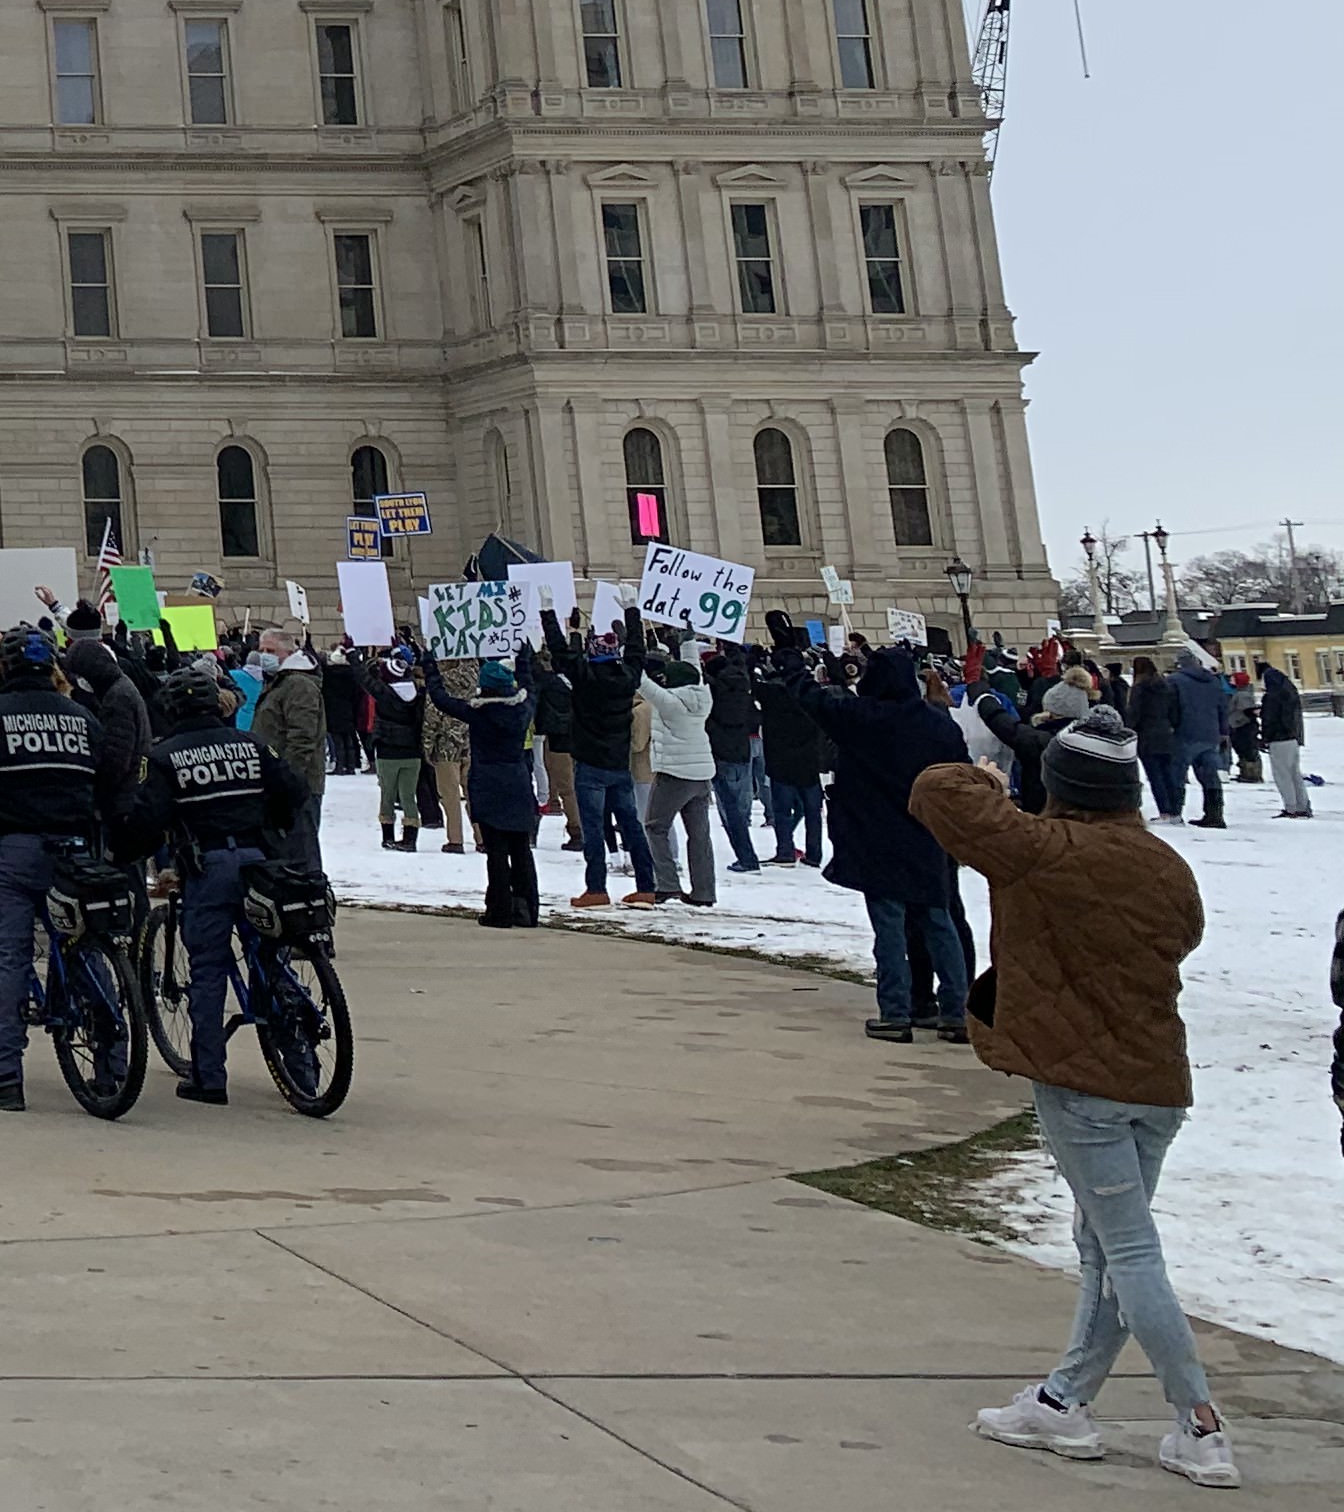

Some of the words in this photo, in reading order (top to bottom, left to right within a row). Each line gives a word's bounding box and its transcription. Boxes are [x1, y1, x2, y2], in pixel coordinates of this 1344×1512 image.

[389, 518, 420, 533] PLAY
[648, 547, 703, 582] Follow
[713, 566, 749, 595] the
[433, 583, 467, 603] LET
[476, 580, 507, 598] MI
[643, 582, 692, 621] data
[432, 597, 508, 639] KIDS
[430, 627, 487, 660] PLAY
[487, 628, 524, 653] #55
[2, 712, 58, 733] MICHIGAN
[60, 715, 89, 736] STATE
[5, 732, 92, 757] POLICE
[169, 745, 226, 770] MICHIGAN
[224, 742, 260, 761] STATE
[176, 759, 262, 789] POLICE
